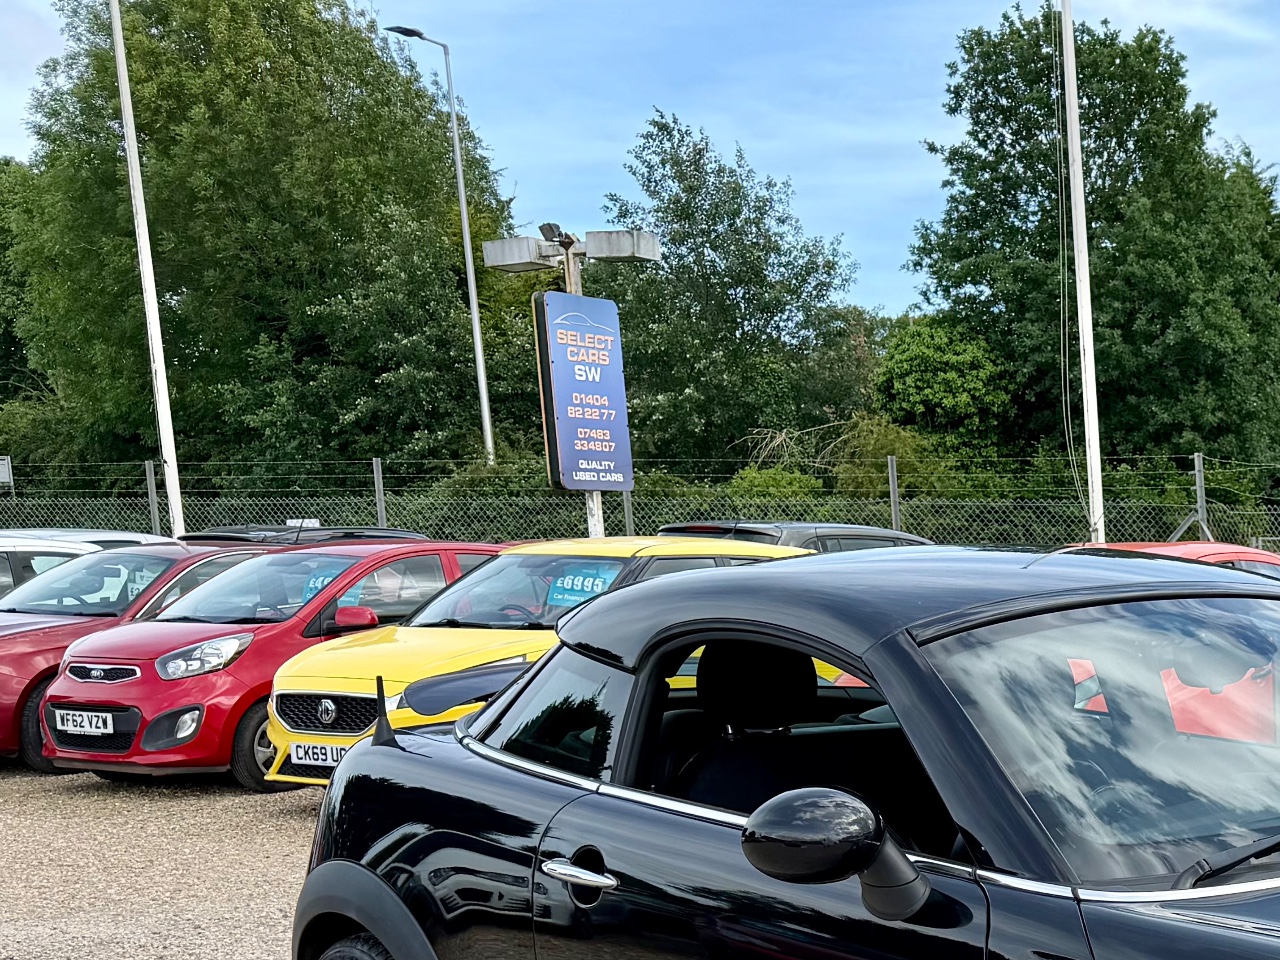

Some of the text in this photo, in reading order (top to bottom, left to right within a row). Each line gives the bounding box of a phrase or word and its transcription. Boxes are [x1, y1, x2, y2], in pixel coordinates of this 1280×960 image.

[557, 329, 615, 350] SELECT
[567, 348, 610, 366] CARS
[574, 365, 601, 383] SW
[572, 393, 609, 406] 01404
[574, 440, 616, 452] 334807
[578, 460, 615, 470] QUALITY
[572, 471, 624, 482] USED CARS
[556, 575, 605, 592] £6995
[59, 712, 108, 730] WF62 VZW
[295, 744, 328, 762] CK69
